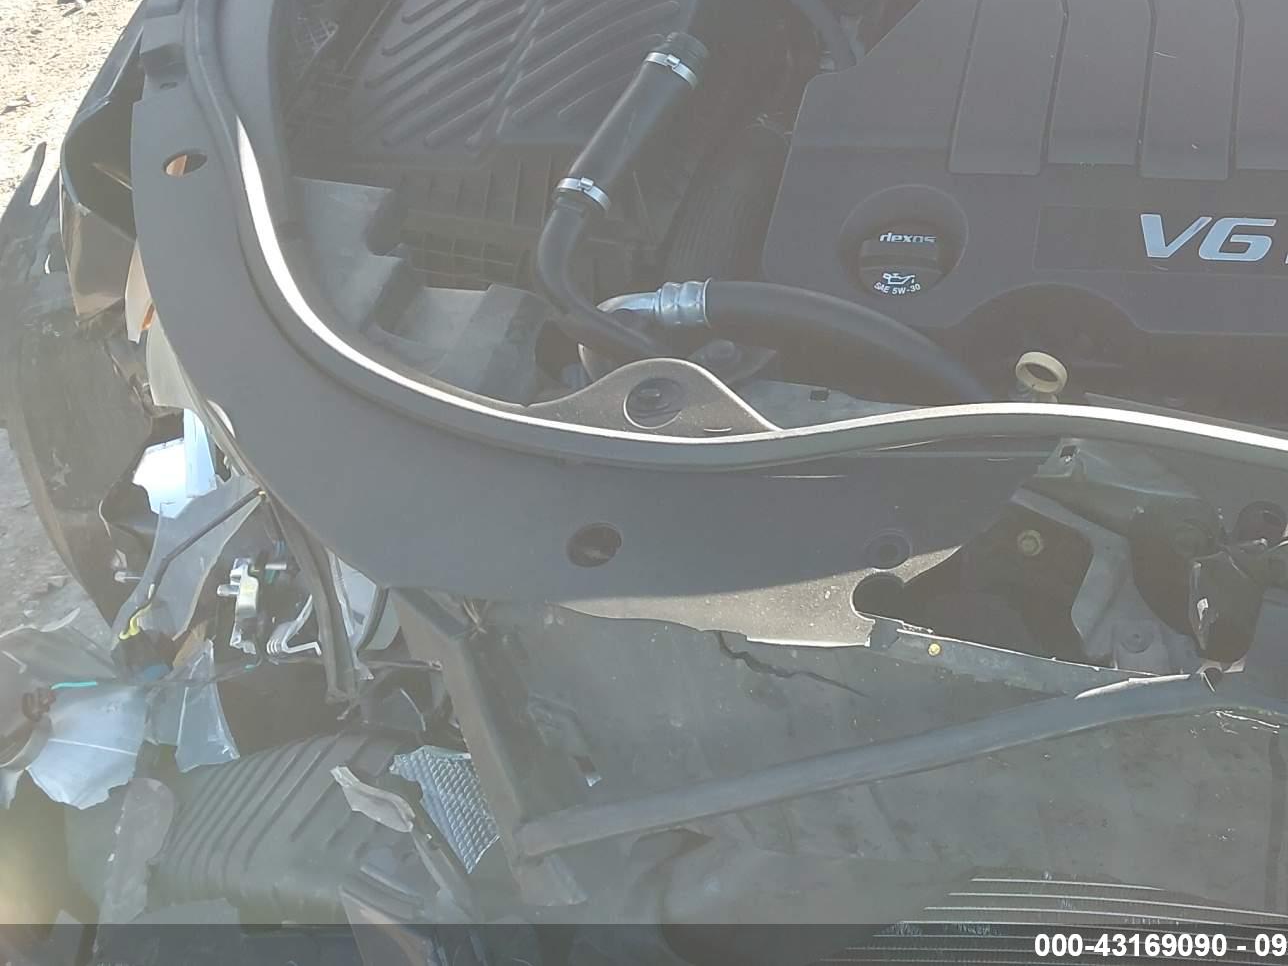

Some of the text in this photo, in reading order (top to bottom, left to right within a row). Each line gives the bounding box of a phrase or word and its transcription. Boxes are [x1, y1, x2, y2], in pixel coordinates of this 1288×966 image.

[1140, 214, 1277, 262] V6
[874, 282, 920, 294] SAE 5W-30
